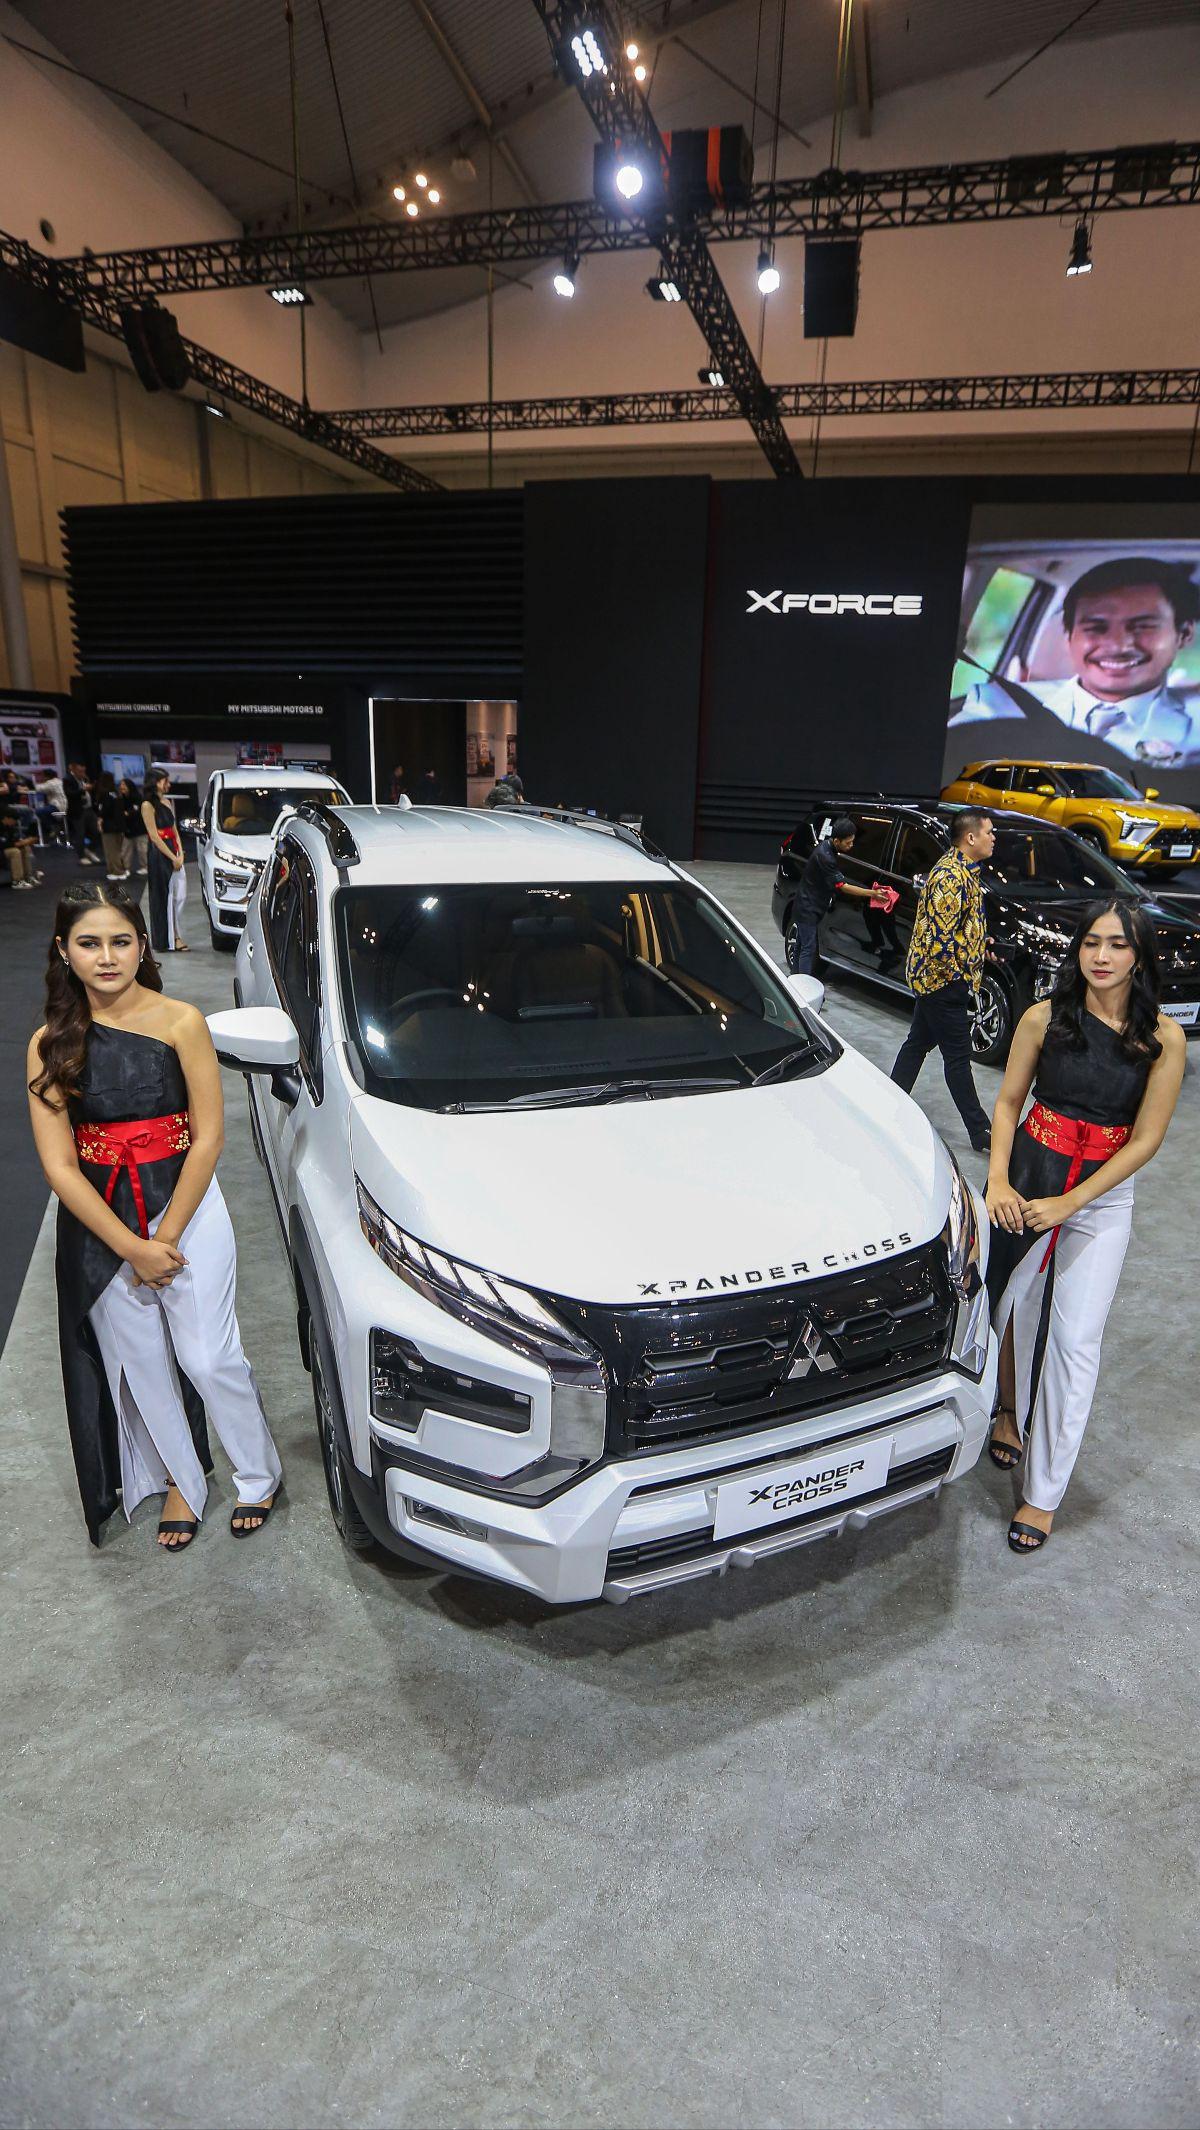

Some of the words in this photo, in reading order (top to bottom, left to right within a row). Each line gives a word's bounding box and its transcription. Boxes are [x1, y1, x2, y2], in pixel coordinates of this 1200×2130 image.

[746, 590, 922, 615] XFORCE
[227, 704, 240, 713] MY
[240, 704, 282, 714] MITSUBISHI
[283, 705, 314, 714] MOTORS
[314, 705, 324, 714] ID
[1161, 1010, 1195, 1018] PANDER
[636, 1261, 810, 1296] XPANDER
[823, 1232, 912, 1268] CROSS
[747, 1459, 865, 1506] XPANDER
[772, 1478, 848, 1511] CROSS
